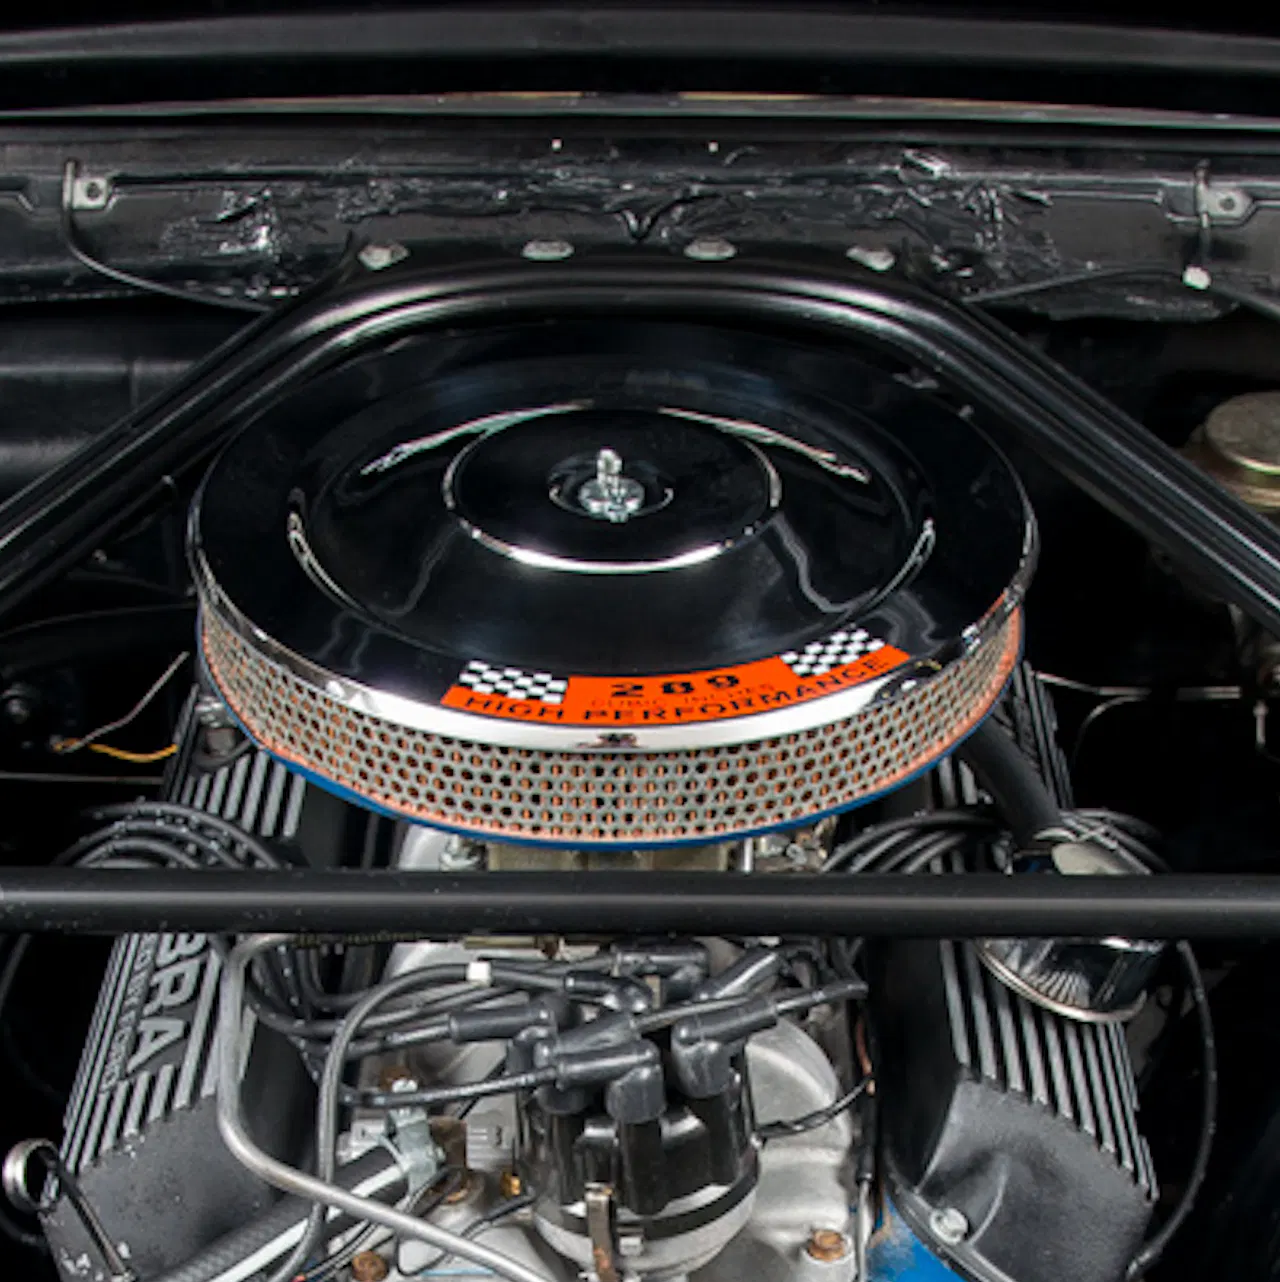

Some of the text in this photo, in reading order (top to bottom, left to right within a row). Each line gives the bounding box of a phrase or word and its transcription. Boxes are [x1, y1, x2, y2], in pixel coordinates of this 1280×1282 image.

[465, 657, 889, 721] HIGH PERFORMANCE
[611, 673, 740, 698] 289
[127, 933, 206, 1074] BRA
